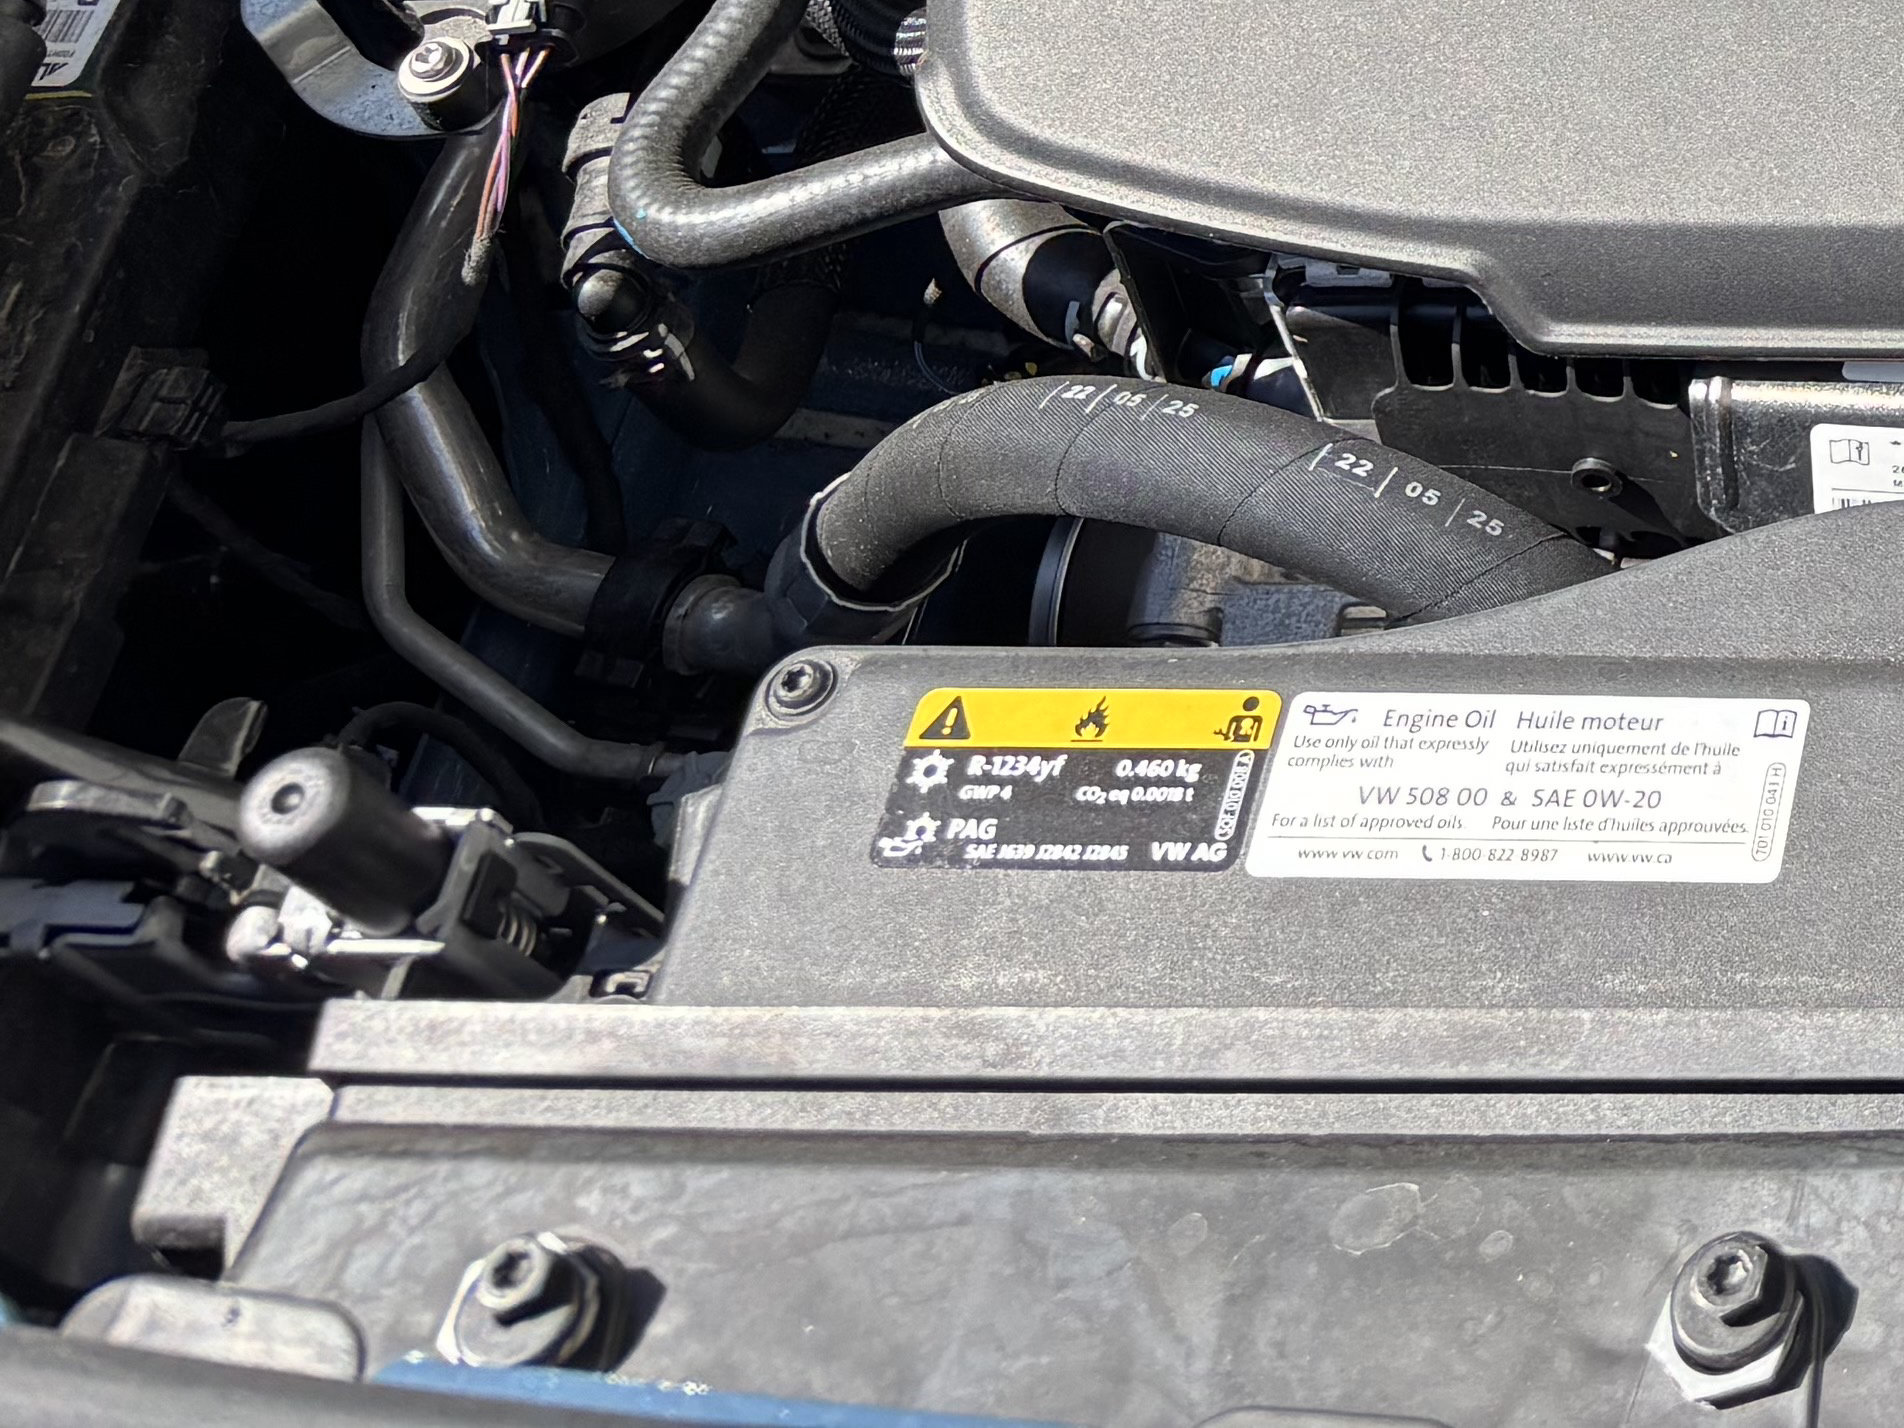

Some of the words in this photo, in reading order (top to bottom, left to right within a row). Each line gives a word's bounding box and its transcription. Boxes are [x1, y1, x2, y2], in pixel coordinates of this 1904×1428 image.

[1383, 709, 1459, 734] Engine
[1464, 709, 1497, 729] Oil
[1516, 710, 1575, 730] Huile
[1581, 713, 1664, 731] moteur
[1293, 735, 1322, 749] Use
[1324, 735, 1358, 753] only
[1360, 735, 1380, 749] oil
[1383, 735, 1414, 750] that
[1418, 736, 1489, 755] expressly
[1510, 739, 1567, 754] Utilisez
[1571, 743, 1666, 758] uniquement
[1670, 741, 1690, 756] de
[966, 754, 1068, 783] R-1234yf
[1114, 758, 1175, 778] 0.460
[1175, 758, 1203, 783] kg
[1287, 753, 1354, 772] complies
[1359, 755, 1394, 768] with
[1505, 761, 1530, 776] qui
[1535, 758, 1595, 774] satisfait
[1599, 761, 1709, 778] expressément
[1712, 761, 1722, 775] à
[1359, 786, 1401, 805] VW
[1405, 786, 1450, 806] 508
[1456, 787, 1488, 807] 00
[1500, 790, 1517, 807] &
[1531, 788, 1577, 808] SAE
[1582, 789, 1662, 809] 0W-20
[945, 818, 998, 840] PAG
[1271, 813, 1296, 827] For
[1299, 816, 1308, 828] a
[1313, 813, 1336, 828] list
[1340, 813, 1357, 828] of
[1359, 814, 1435, 832] approved
[1491, 815, 1526, 830] Pour
[1530, 820, 1559, 831] une
[1562, 816, 1595, 831] liste
[1597, 817, 1655, 832] d'huiles
[1150, 841, 1192, 862] VW
[1190, 841, 1228, 863] AG
